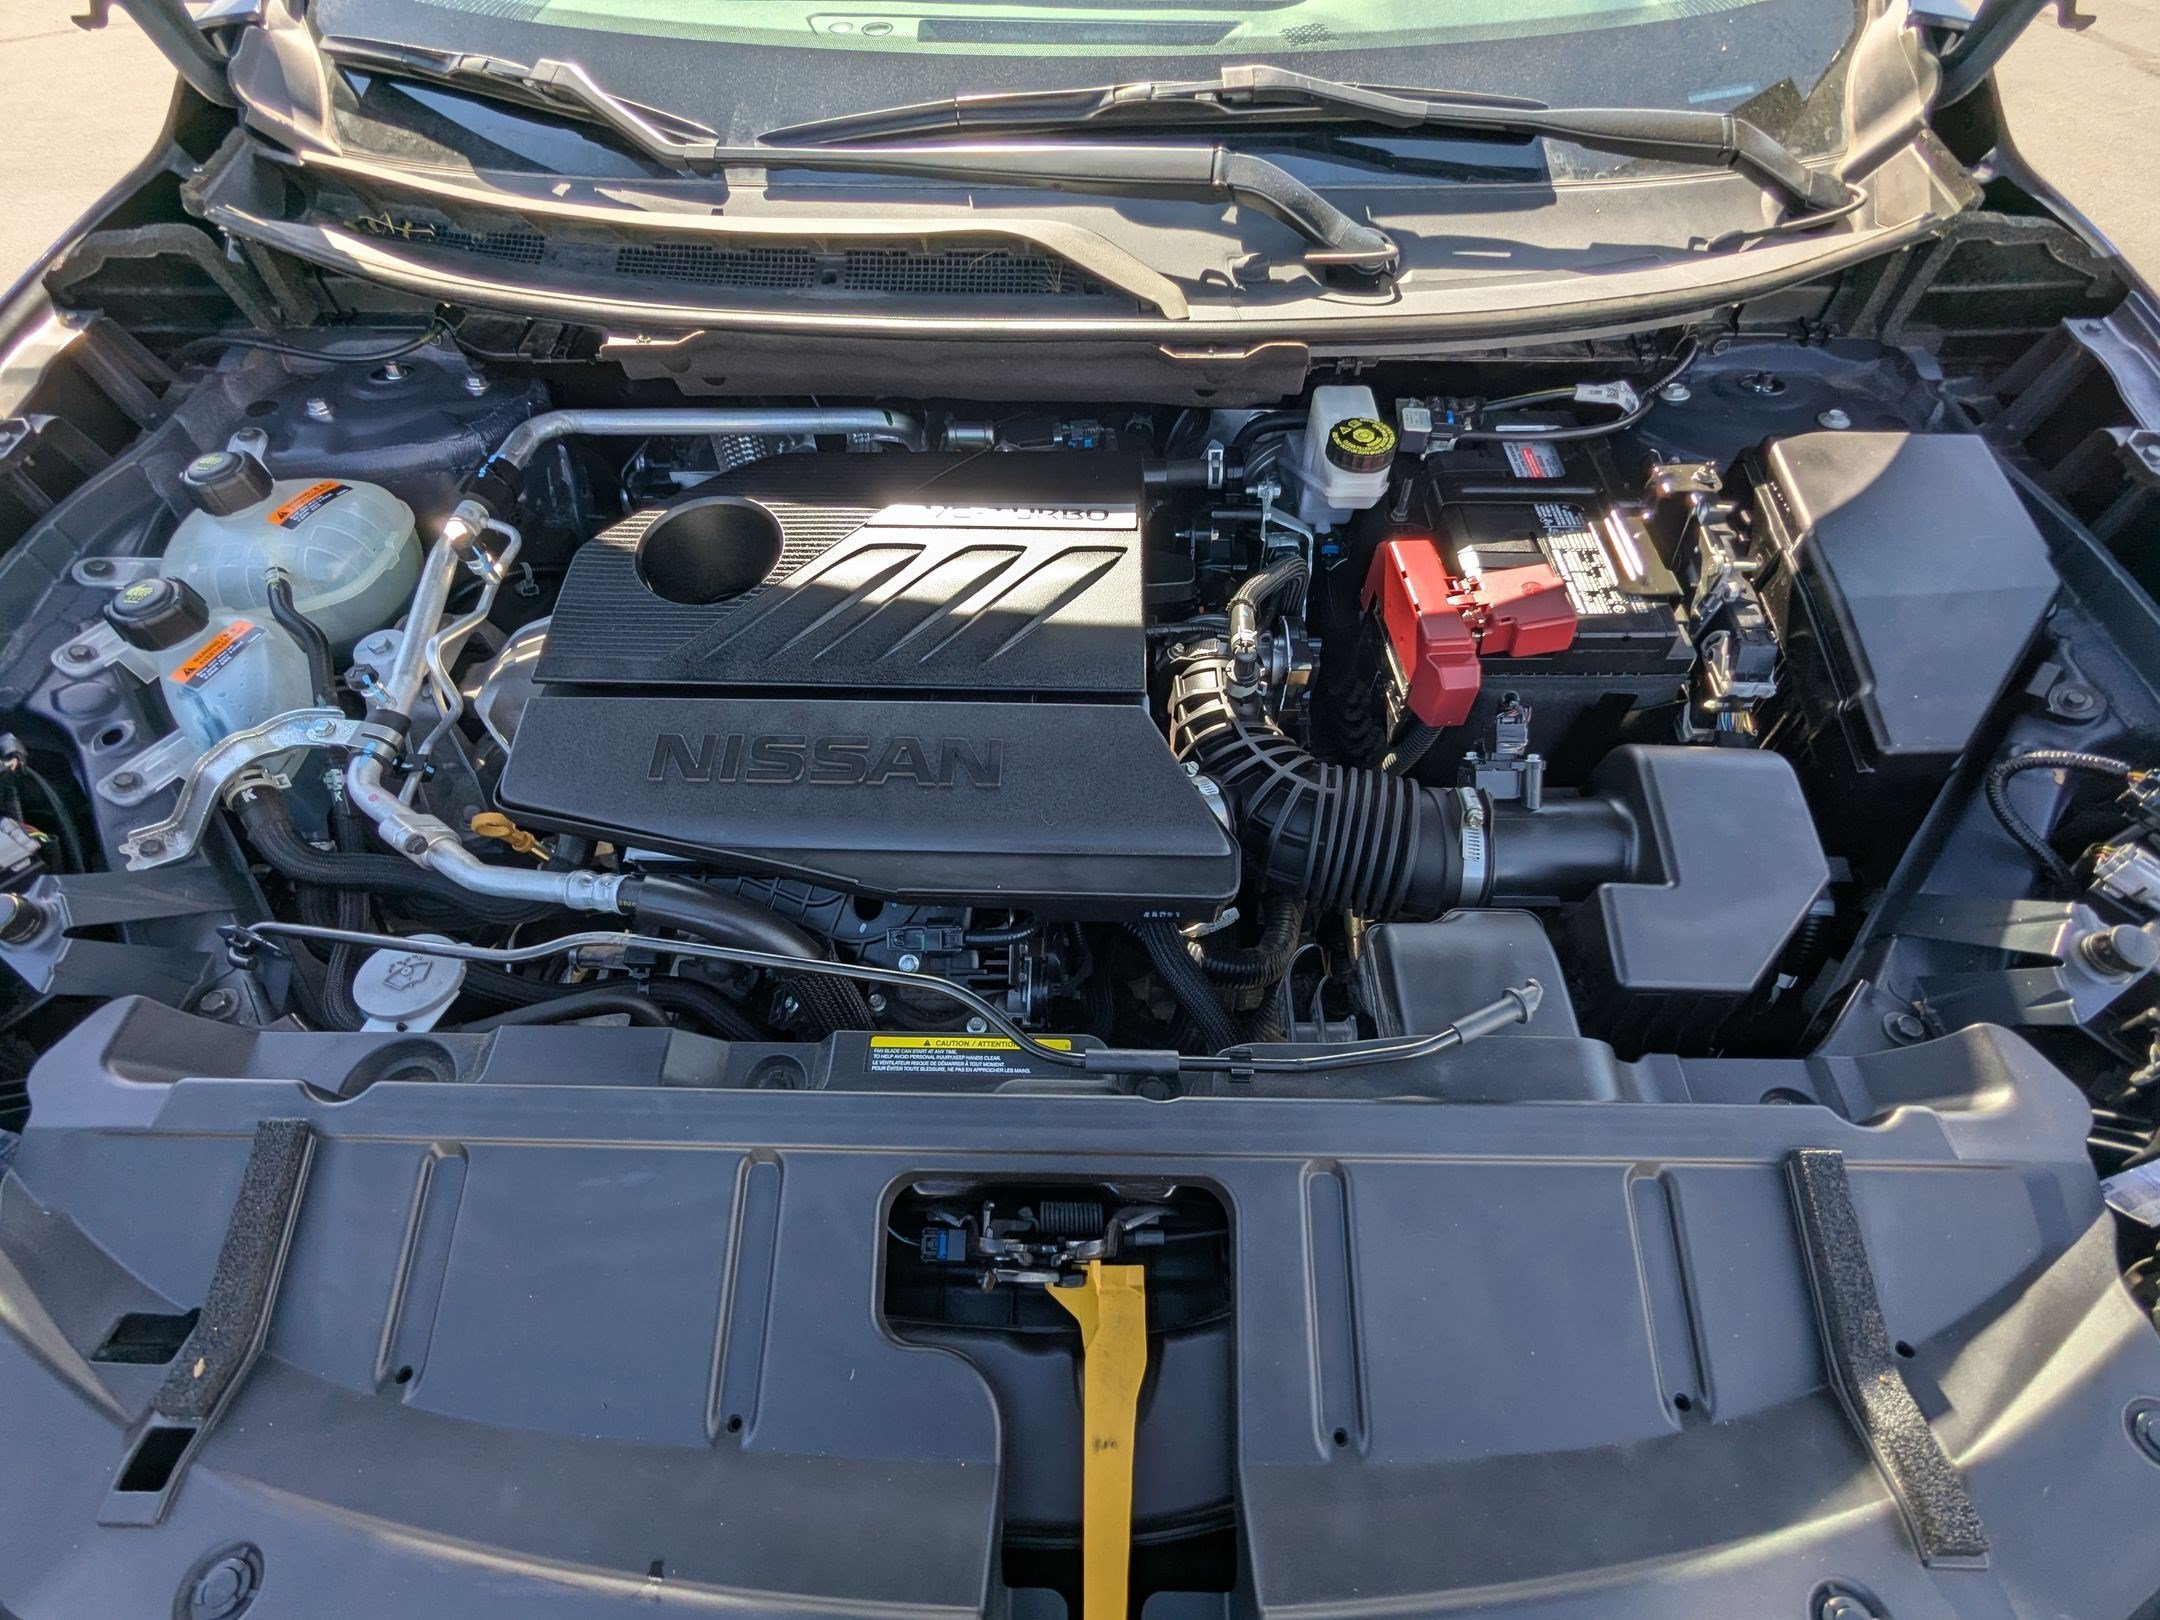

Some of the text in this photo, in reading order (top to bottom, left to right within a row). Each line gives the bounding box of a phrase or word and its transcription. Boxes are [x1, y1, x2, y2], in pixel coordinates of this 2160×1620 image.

[647, 734, 1002, 788] NISSAN
[241, 787, 258, 803] K
[334, 791, 344, 802] K
